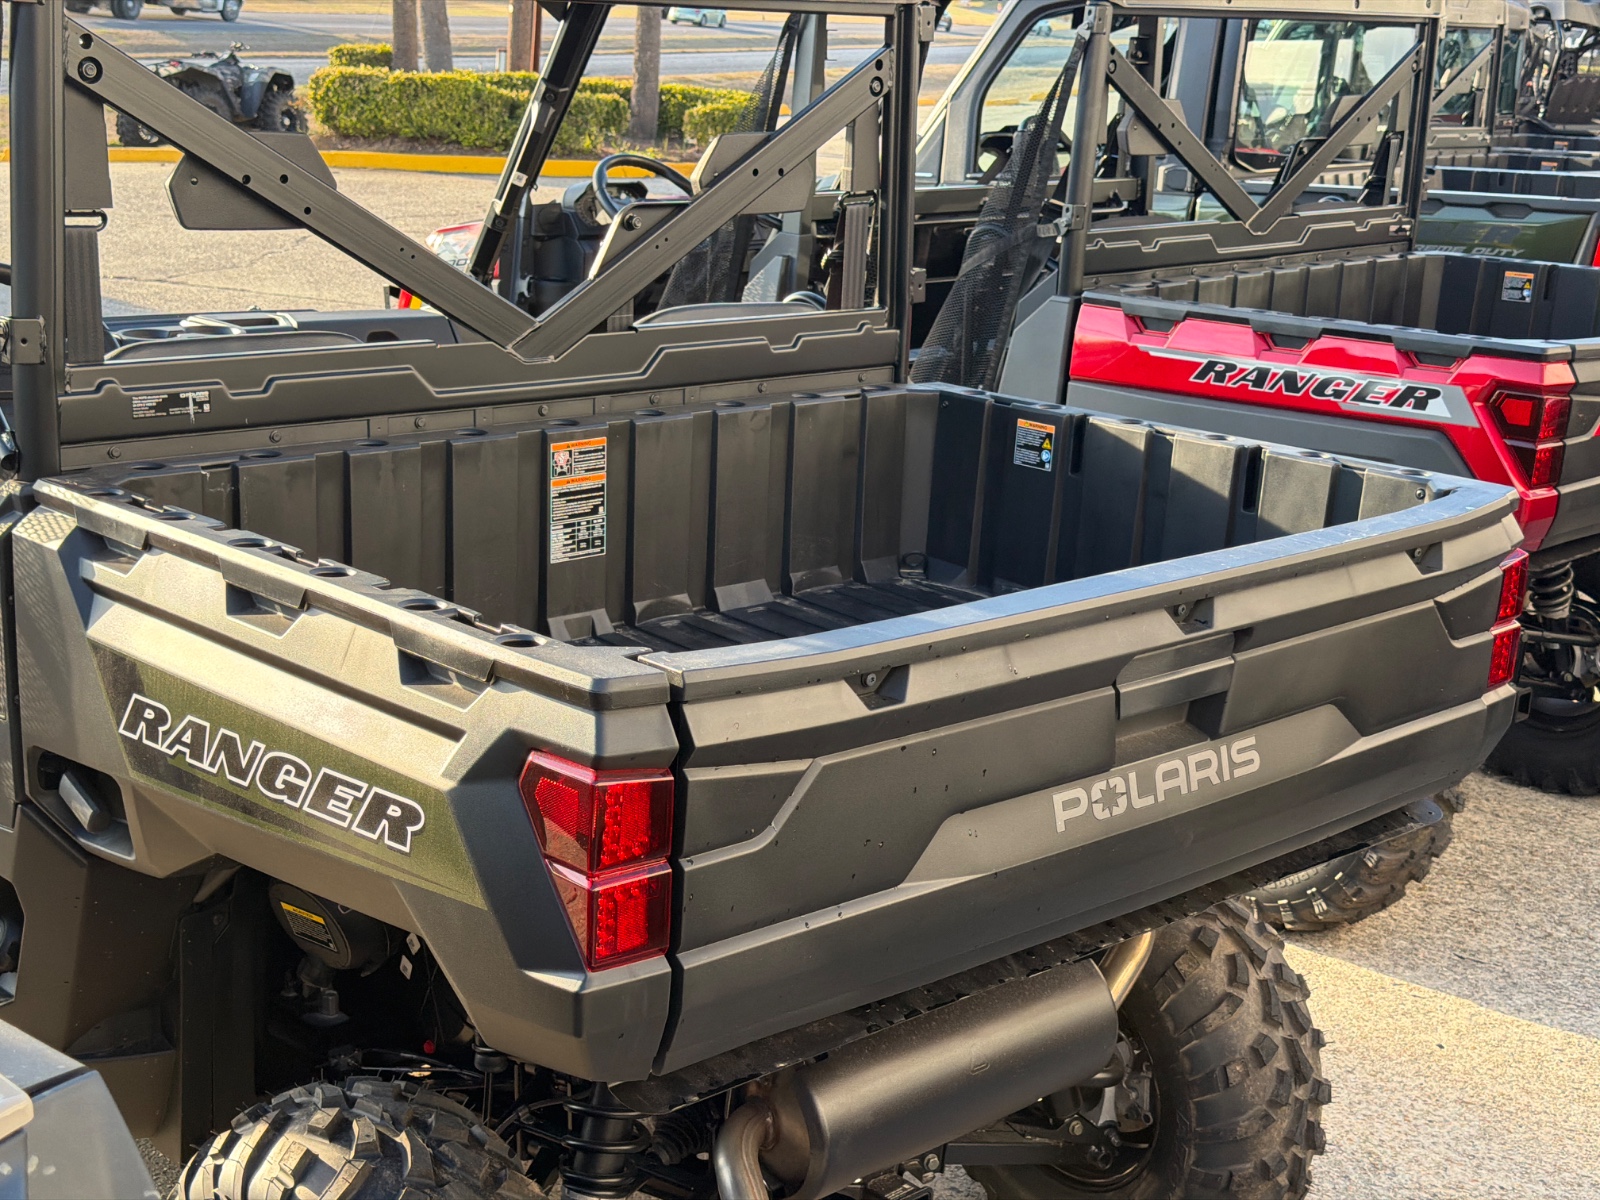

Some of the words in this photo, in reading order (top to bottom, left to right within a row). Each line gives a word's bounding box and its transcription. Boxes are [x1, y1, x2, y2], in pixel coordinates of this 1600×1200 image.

[1471, 246, 1526, 257] DUTY
[1190, 358, 1442, 412] RANGER
[118, 693, 426, 854] RANGER
[1052, 736, 1261, 833] POLARIS
